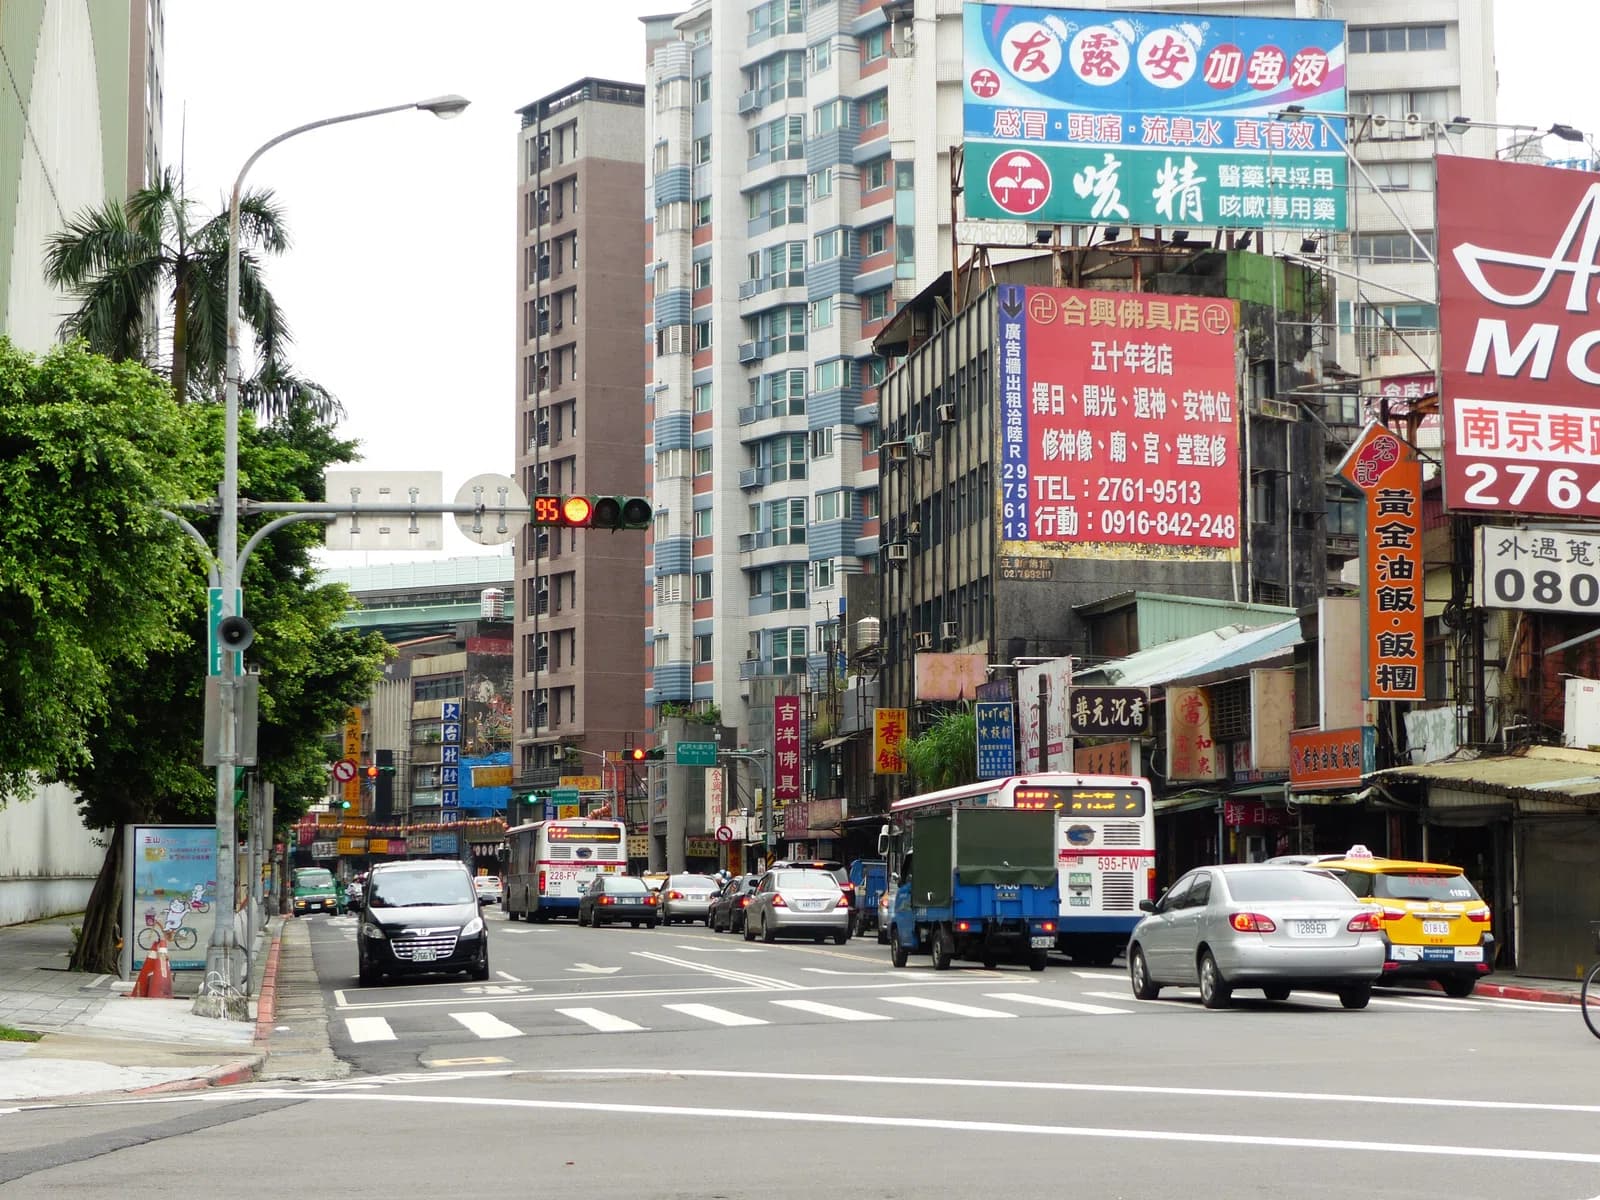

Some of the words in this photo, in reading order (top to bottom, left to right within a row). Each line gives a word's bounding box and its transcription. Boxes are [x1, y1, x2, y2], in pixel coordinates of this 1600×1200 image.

[1011, 30, 1190, 81] 友露安
[1203, 49, 1330, 92] 加強液
[1218, 164, 1335, 192] 醫藥界採用
[1218, 194, 1336, 221] 咳嗽專用藥
[1061, 296, 1200, 333] 合興佛具店
[1090, 340, 1173, 375] 五十年老店
[1004, 464, 1027, 479] 29
[1004, 483, 1027, 499] 75
[1097, 477, 1201, 505] 2761-9513
[535, 498, 559, 521] 95
[1004, 503, 1026, 518] 61
[1004, 522, 1027, 538] 13
[1101, 509, 1235, 539] 0916-842-248
[1497, 535, 1600, 566] 外遇蒐
[776, 702, 799, 793] 吉洋佛具
[1098, 857, 1140, 870] 595-FW
